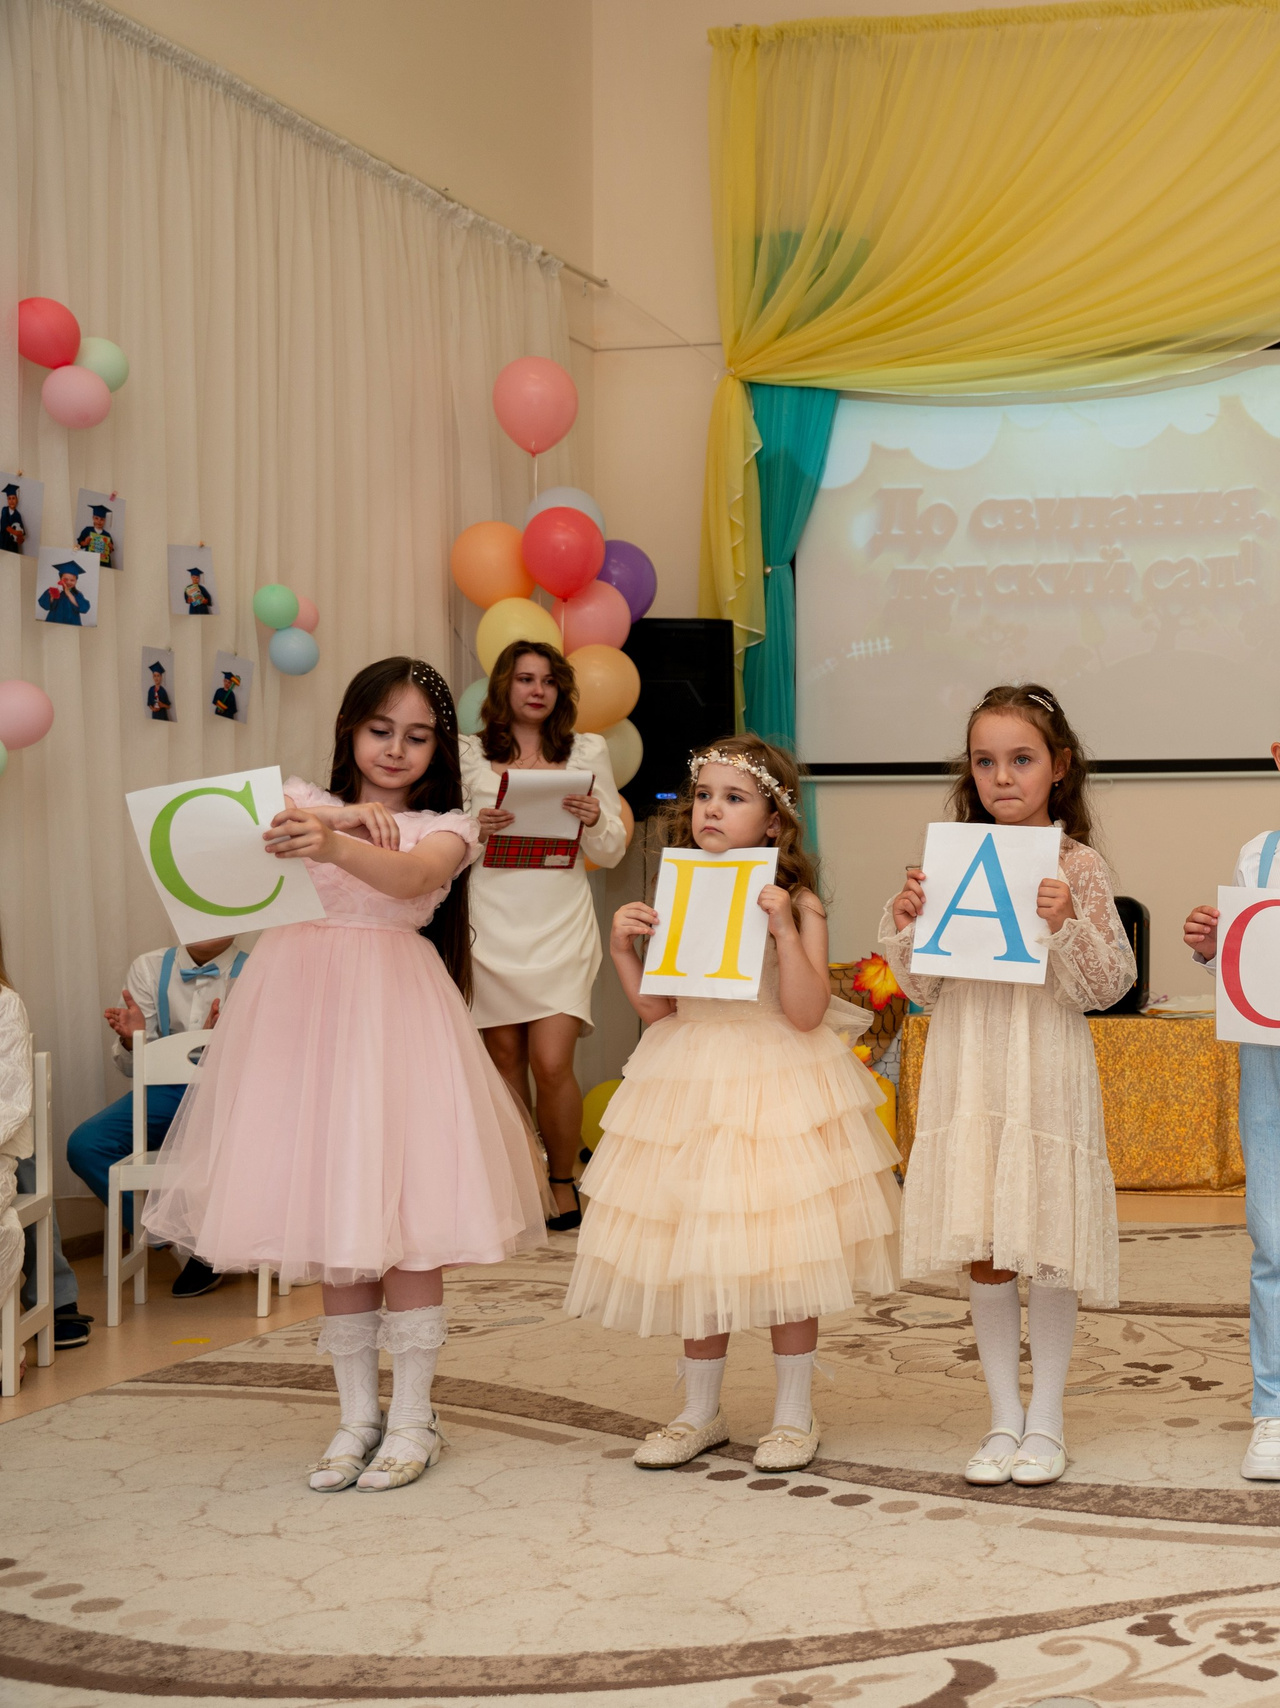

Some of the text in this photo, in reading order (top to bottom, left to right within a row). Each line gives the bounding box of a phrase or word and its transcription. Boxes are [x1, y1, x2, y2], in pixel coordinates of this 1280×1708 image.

[868, 484, 958, 556] До
[149, 780, 285, 917] С
[913, 832, 1041, 964] А
[644, 858, 769, 981] П
